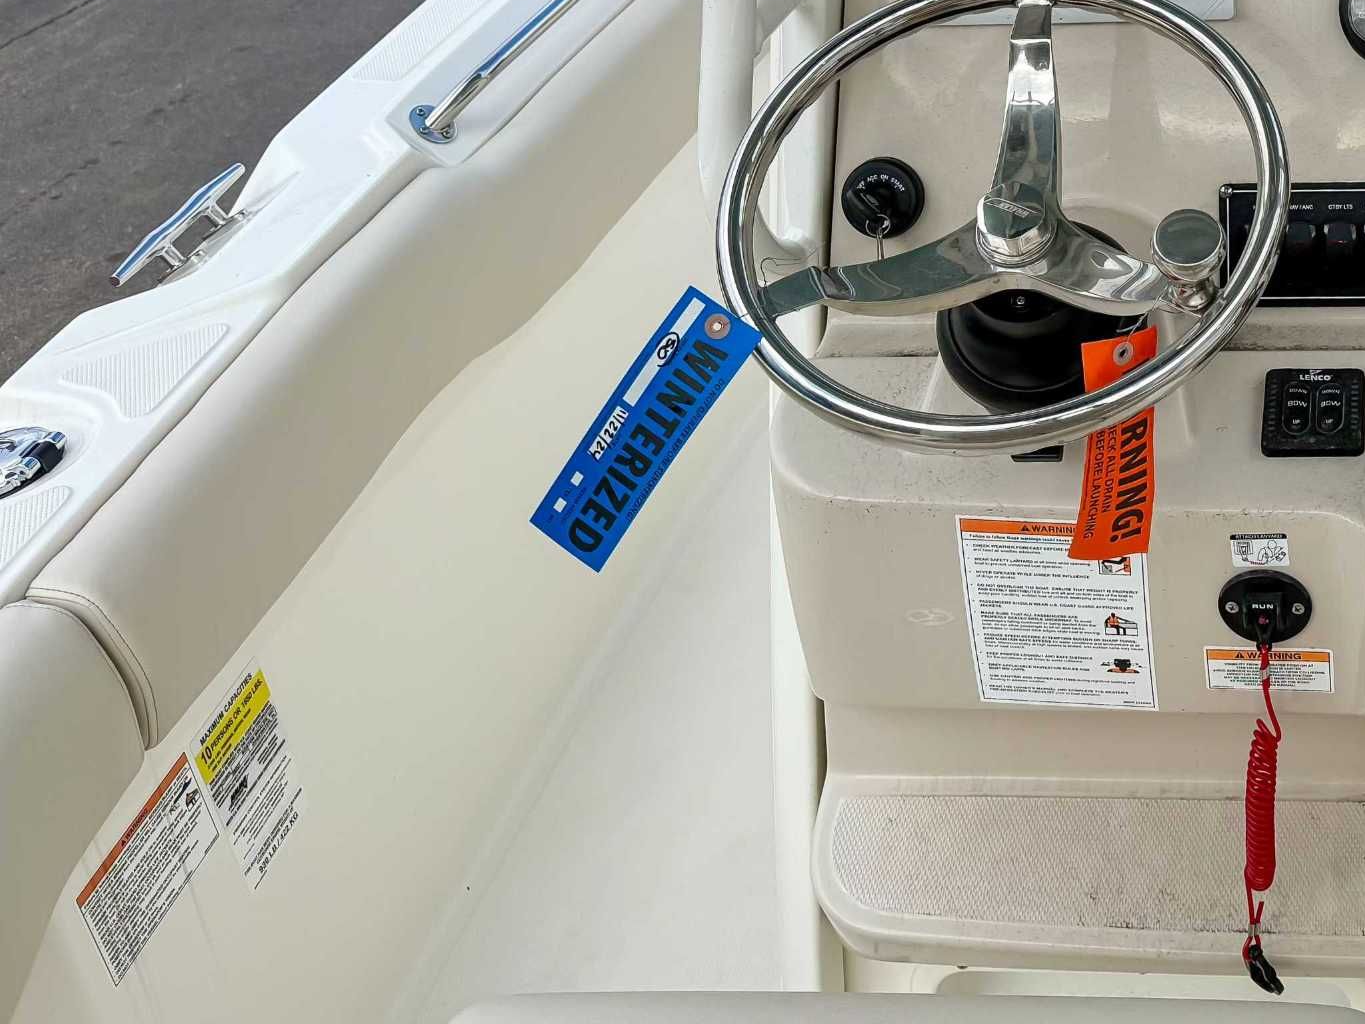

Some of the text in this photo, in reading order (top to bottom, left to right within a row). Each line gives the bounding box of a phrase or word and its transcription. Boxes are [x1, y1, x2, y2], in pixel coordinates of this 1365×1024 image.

[1287, 400, 1308, 408] BOW
[568, 339, 729, 553] WINTERIZED
[1104, 456, 1116, 478] ALL
[1082, 429, 1106, 540] BEFORE LAUNCHING
[1101, 479, 1116, 513] DRAIN
[1110, 415, 1148, 543] RNING!
[1031, 525, 1077, 534] WARNIN
[199, 710, 225, 746] MAXIMUM
[222, 672, 252, 713] CAPACITIES
[200, 746, 214, 763] 10
[210, 718, 235, 750] PERSONS
